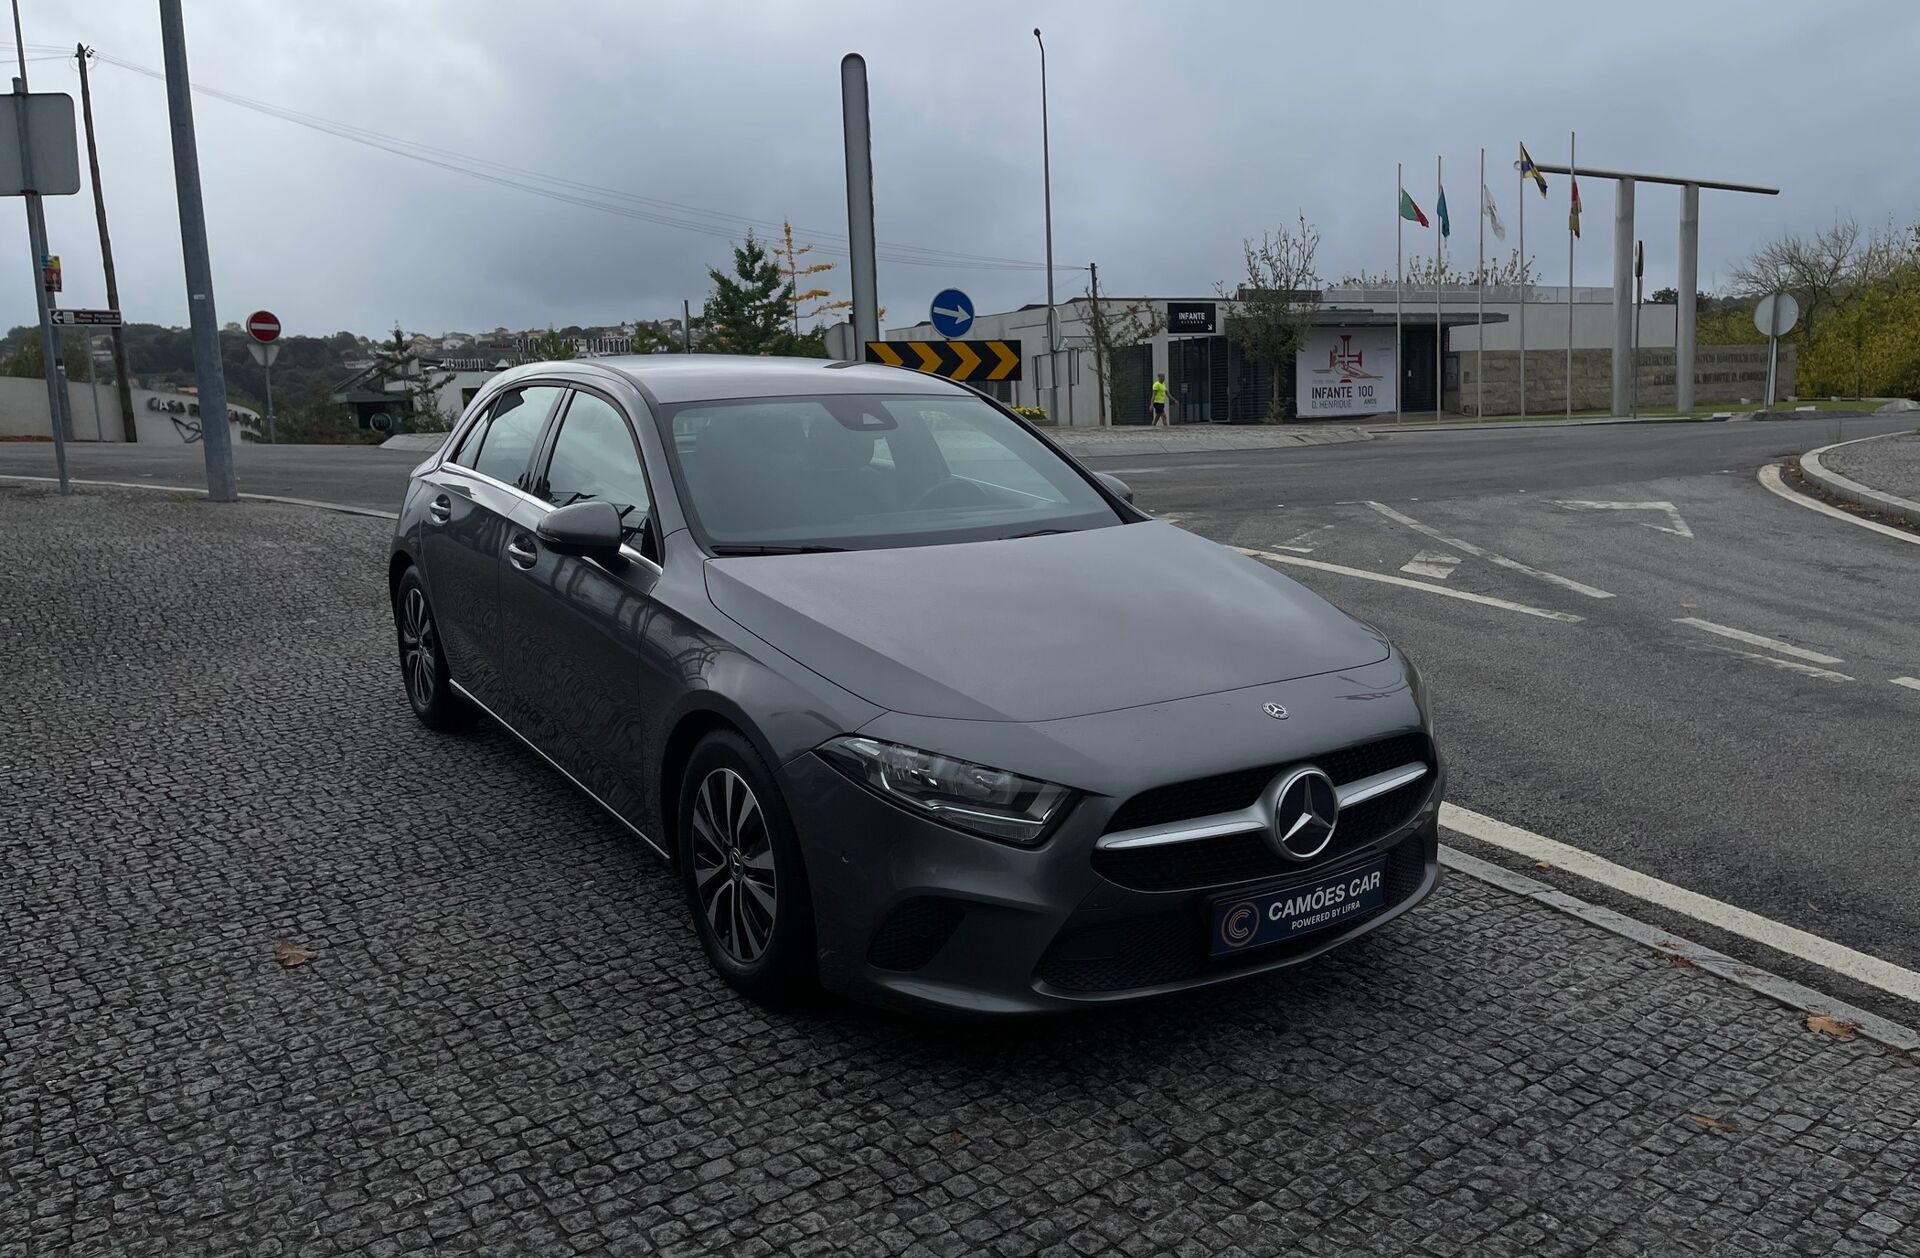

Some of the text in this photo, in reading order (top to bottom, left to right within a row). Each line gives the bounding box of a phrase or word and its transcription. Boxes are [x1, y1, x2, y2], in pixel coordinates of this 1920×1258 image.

[1179, 312, 1205, 320] INFANTE
[1312, 386, 1352, 399] INFANTE
[1358, 385, 1373, 397] 100
[147, 397, 186, 414] CASA
[1319, 399, 1352, 409] HENRIQUE
[1268, 871, 1381, 921] CAMÕES CAR
[1291, 900, 1361, 930] POWERED BY LIFRA
